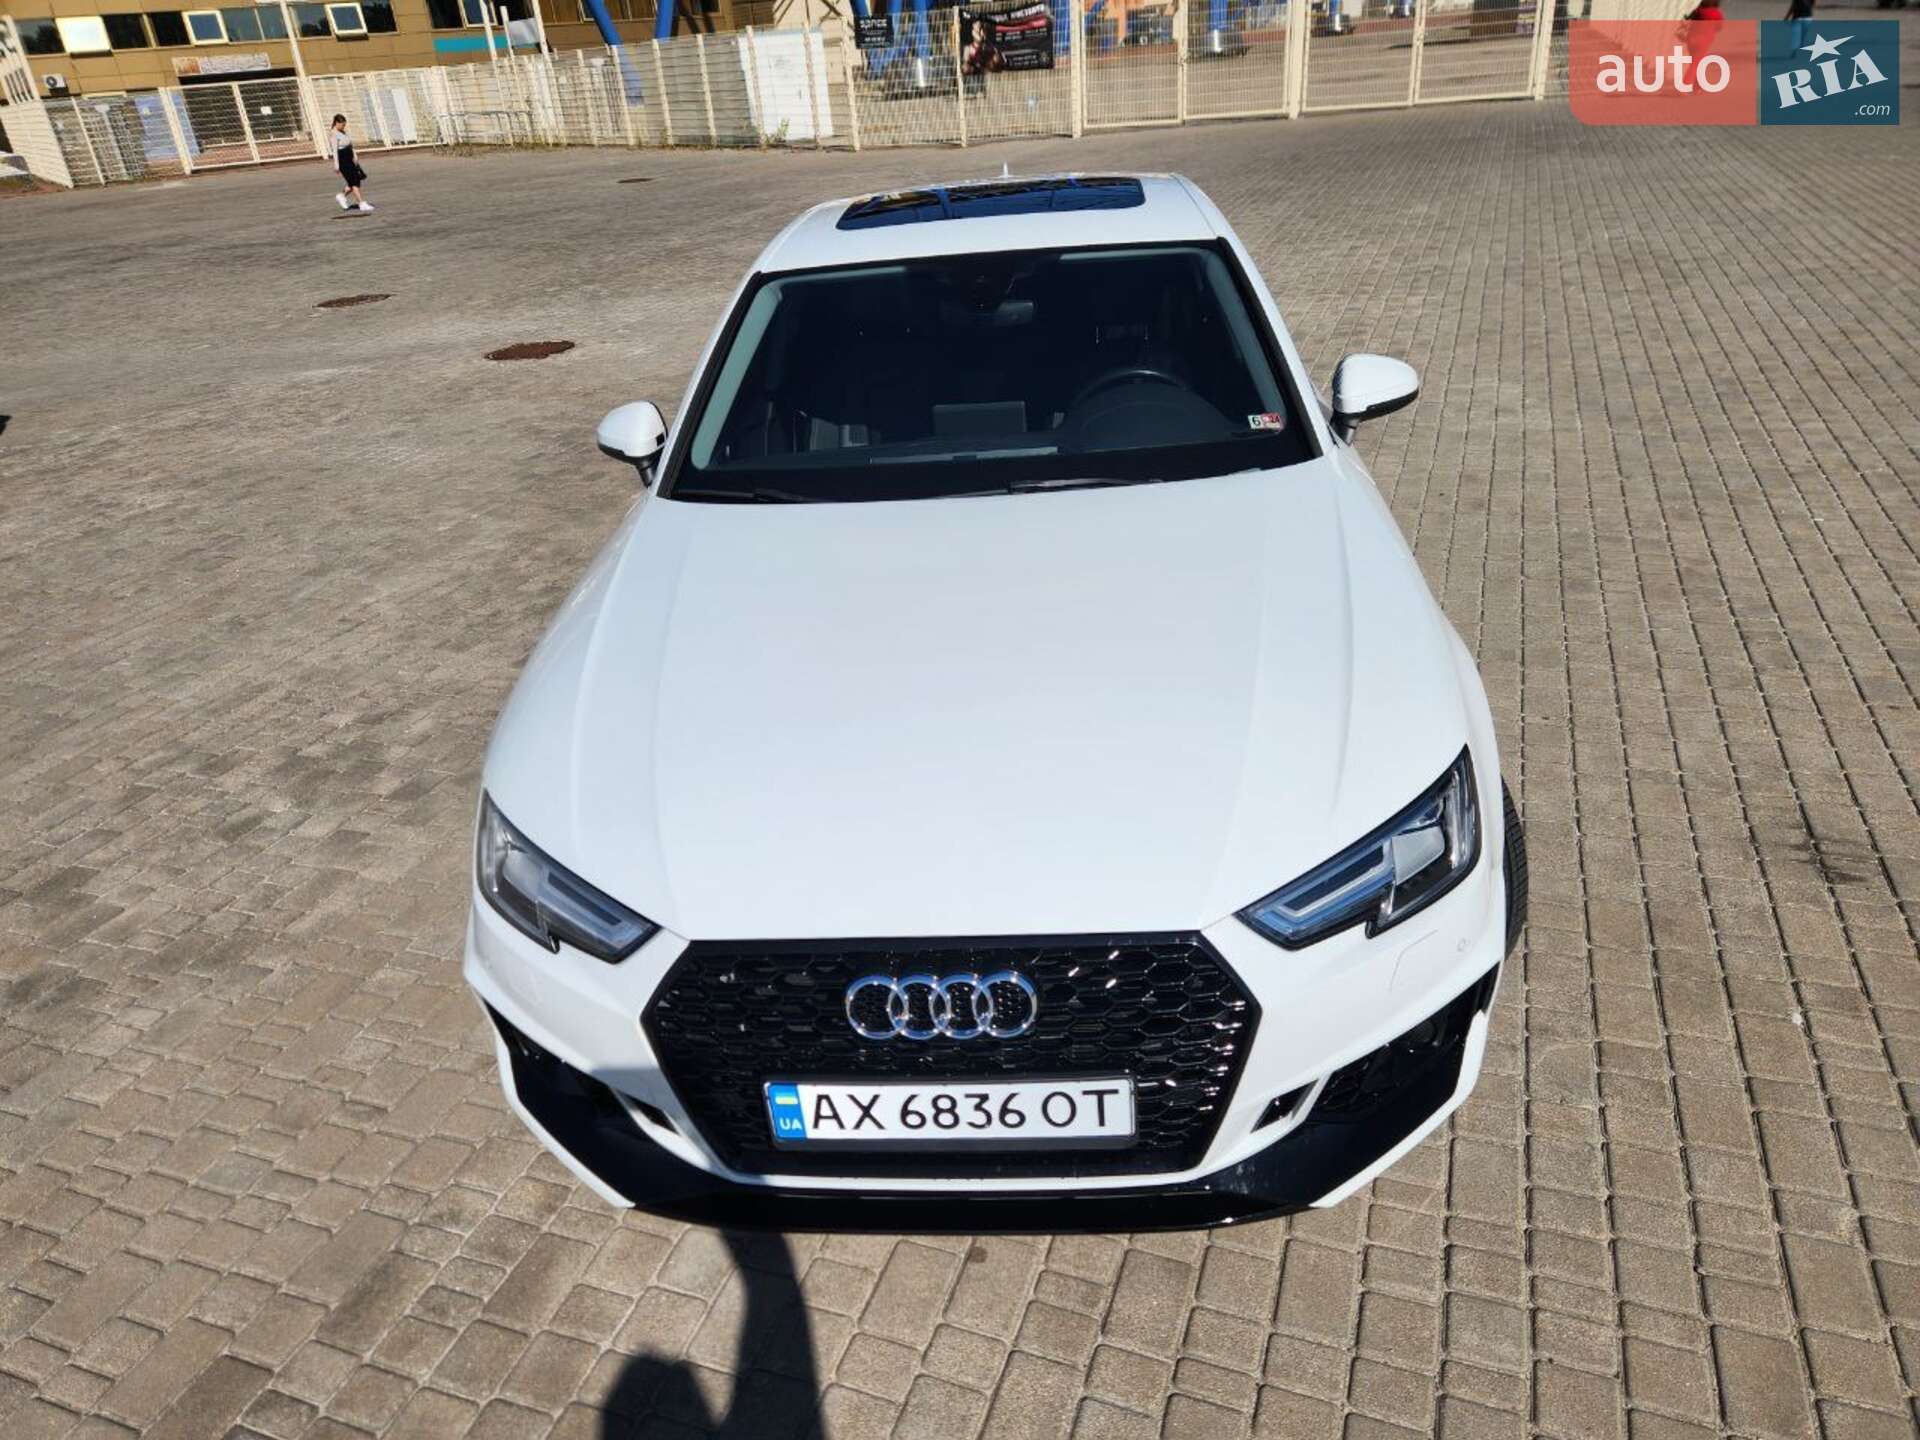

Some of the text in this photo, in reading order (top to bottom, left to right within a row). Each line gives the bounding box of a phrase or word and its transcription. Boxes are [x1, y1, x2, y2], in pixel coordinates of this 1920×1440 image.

[812, 1088, 1120, 1131] AX 6836 OT
[780, 1118, 802, 1131] UA
